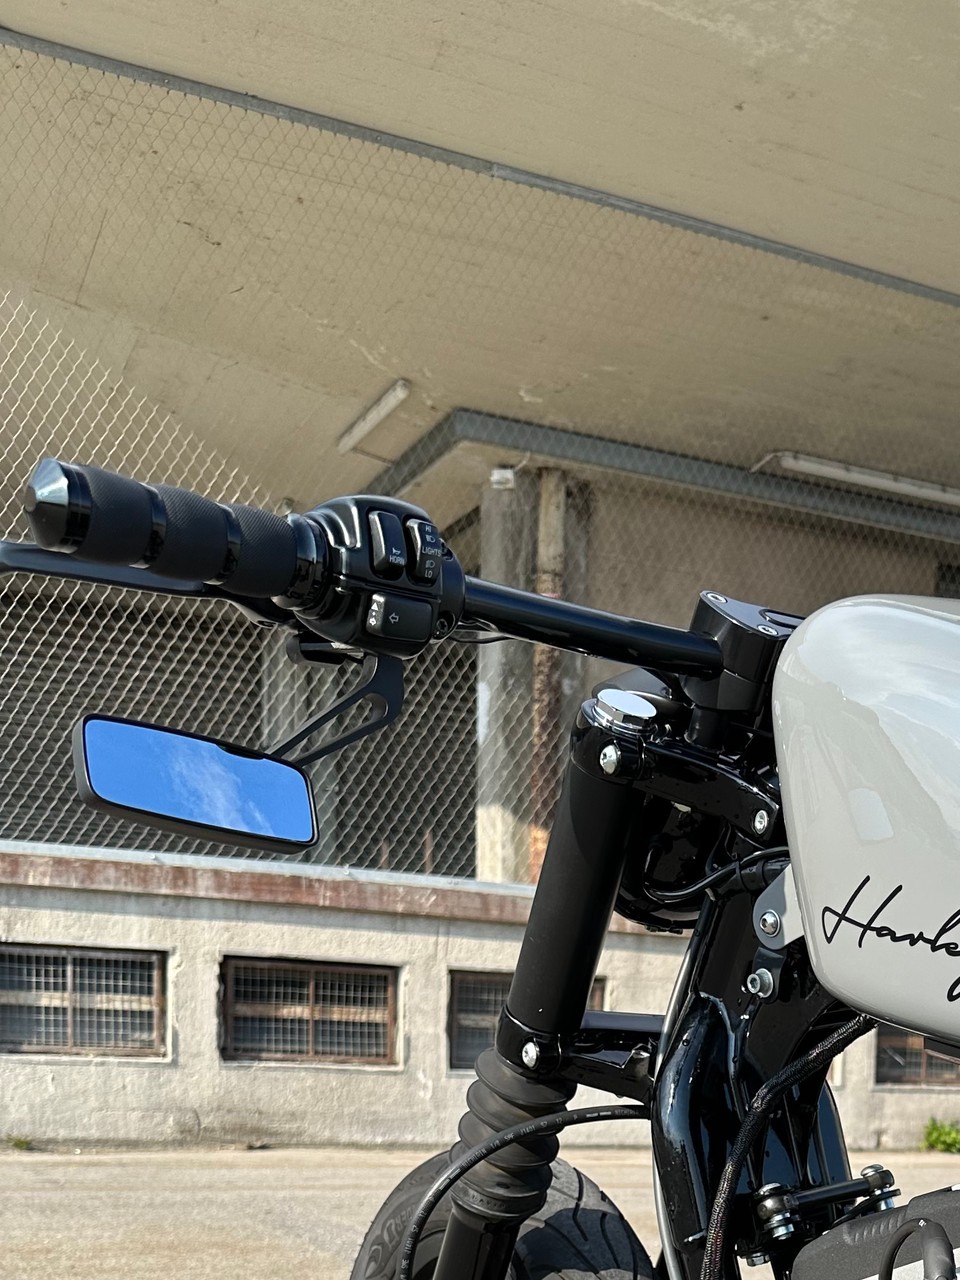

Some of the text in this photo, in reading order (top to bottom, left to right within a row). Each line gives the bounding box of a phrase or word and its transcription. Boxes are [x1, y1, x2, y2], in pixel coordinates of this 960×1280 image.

[422, 546, 441, 557] LIGHTS
[389, 555, 405, 565] HORN
[424, 570, 433, 578] LO
